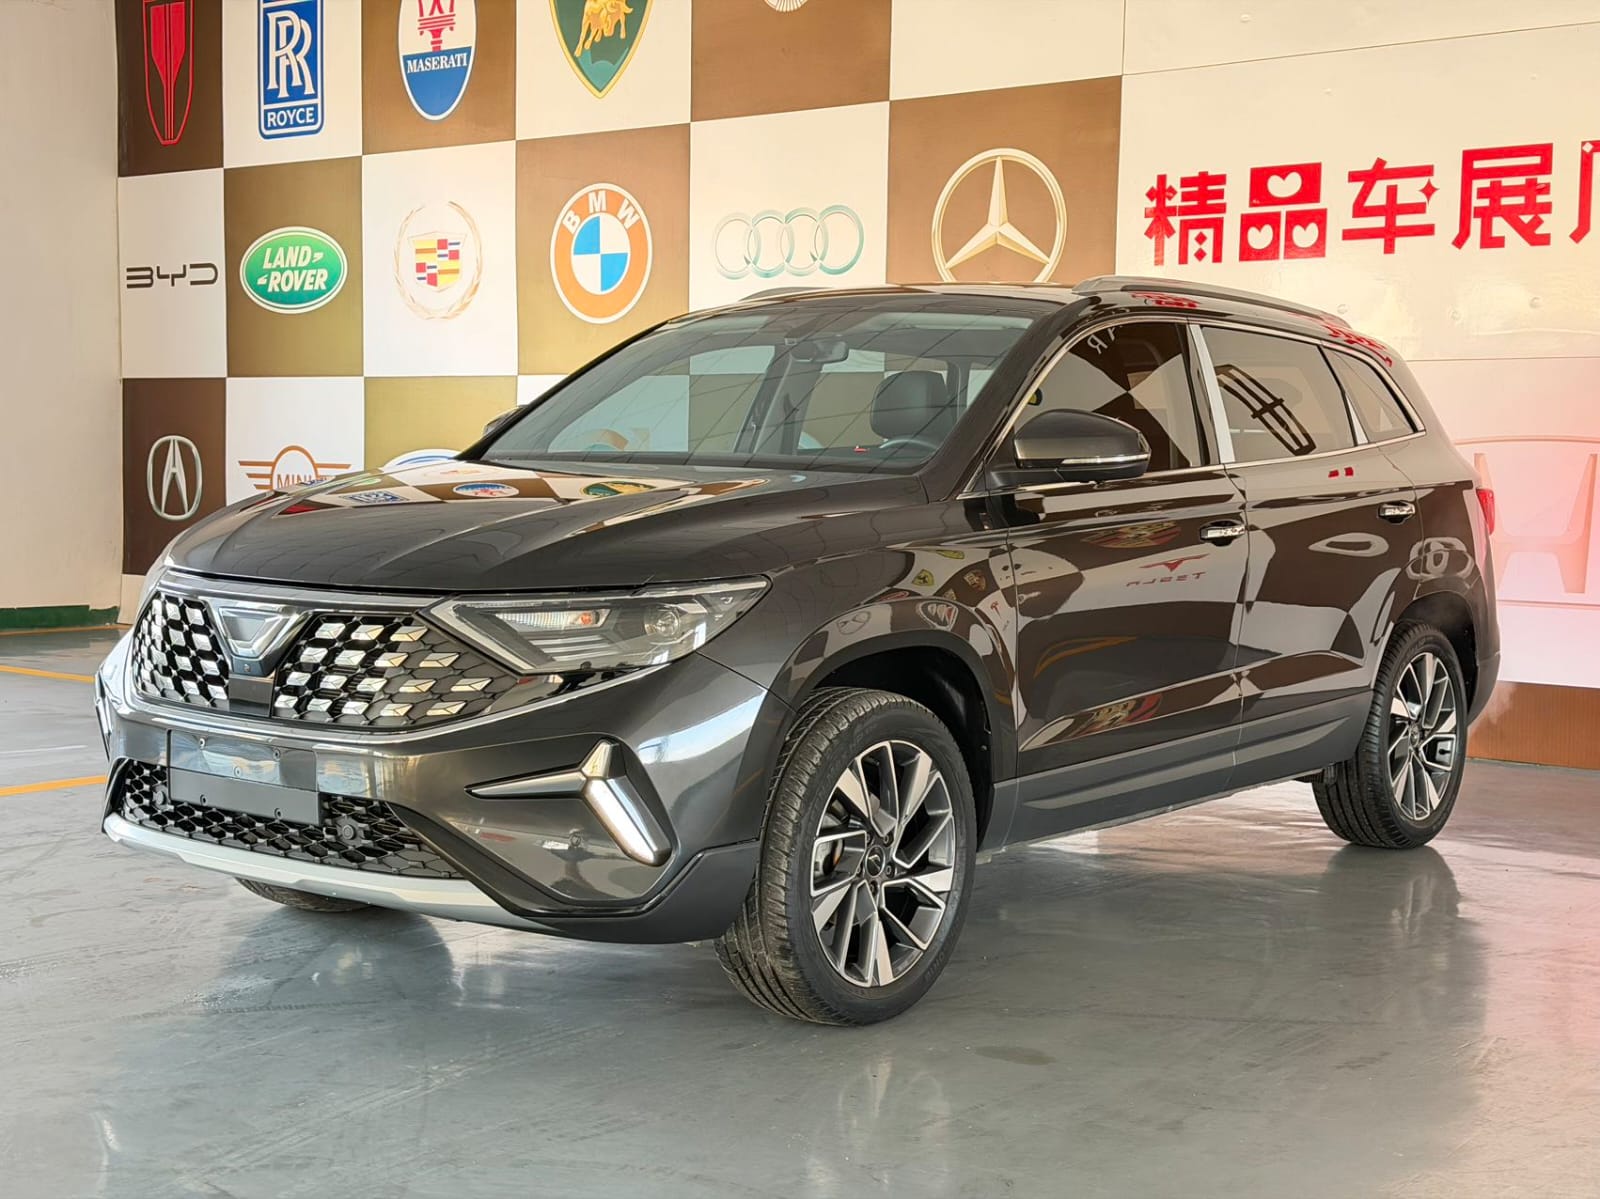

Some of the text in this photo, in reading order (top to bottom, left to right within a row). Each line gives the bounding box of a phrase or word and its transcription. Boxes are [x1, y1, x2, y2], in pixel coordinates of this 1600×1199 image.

[406, 53, 468, 74] MASERATI
[266, 107, 315, 127] ROYCE
[562, 190, 641, 235] BMW
[263, 246, 313, 269] LAND
[126, 262, 219, 289] BYD
[267, 268, 329, 293] ROVER
